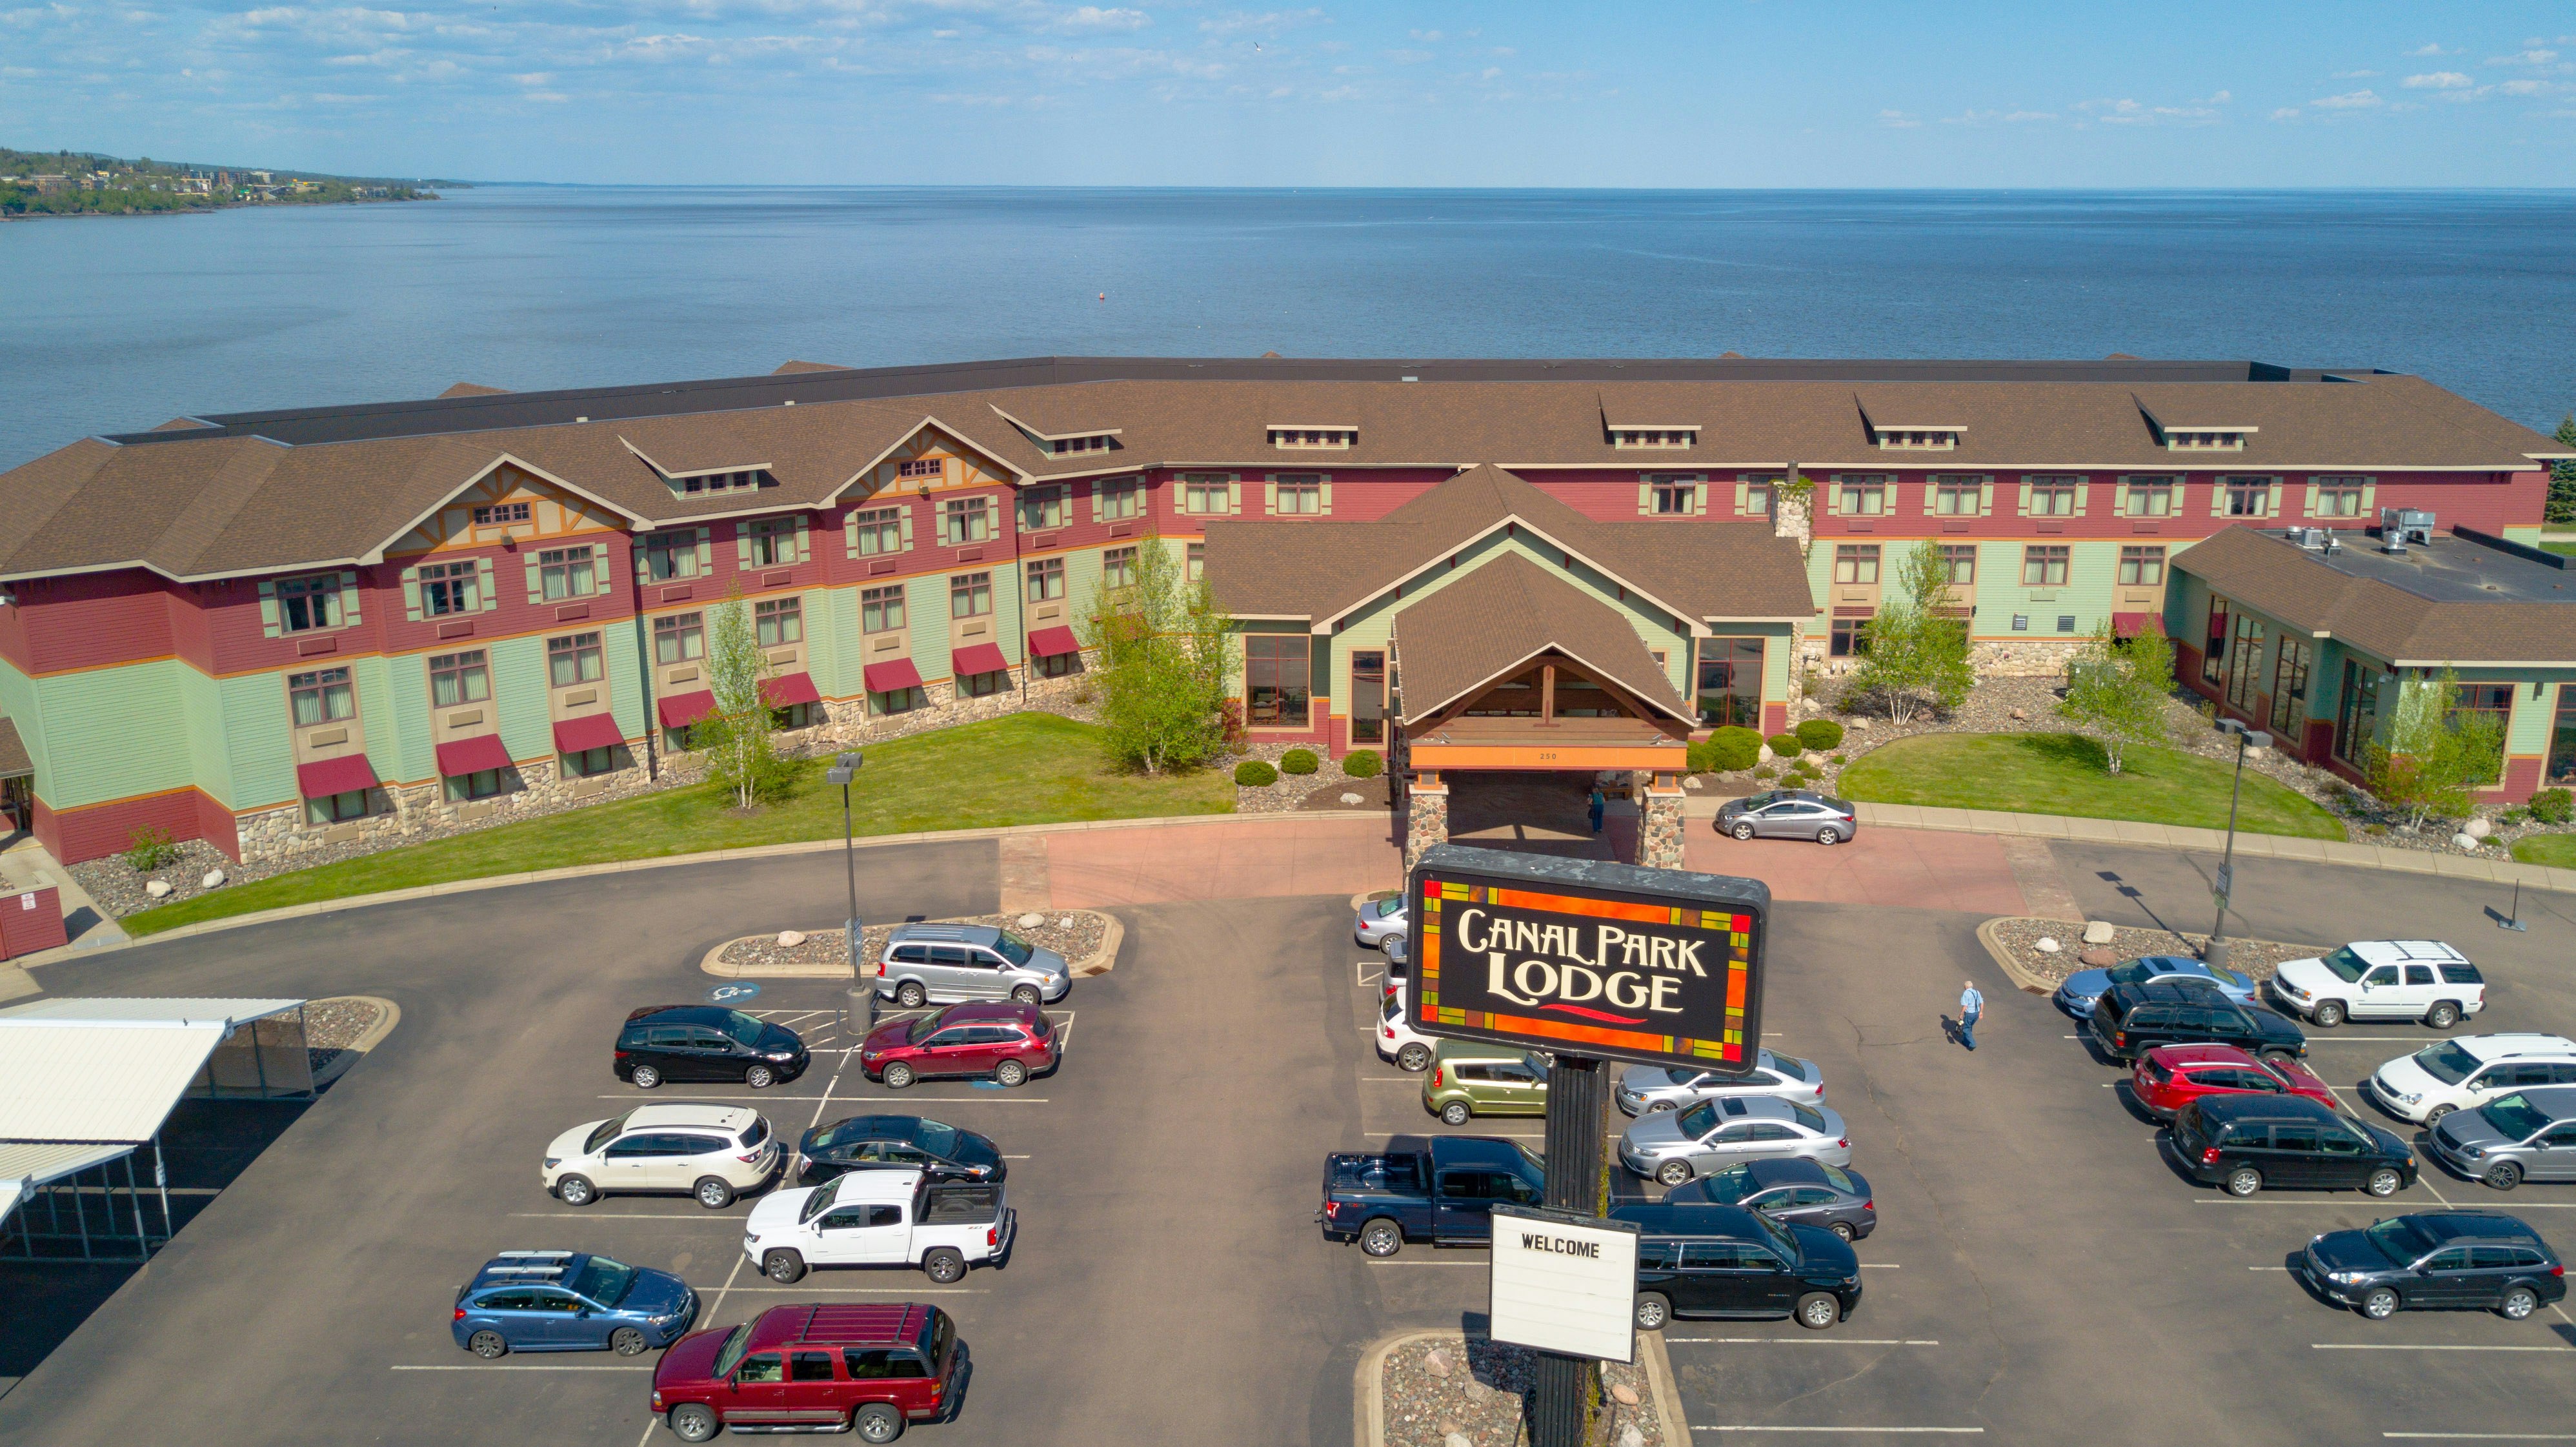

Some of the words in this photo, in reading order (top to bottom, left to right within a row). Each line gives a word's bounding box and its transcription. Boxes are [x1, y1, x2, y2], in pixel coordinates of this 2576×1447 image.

[1458, 909, 1596, 966] CANAL
[1596, 925, 1707, 977] PARK
[1487, 952, 1684, 1013] LODGE
[1522, 1233, 1599, 1258] WELCOME
